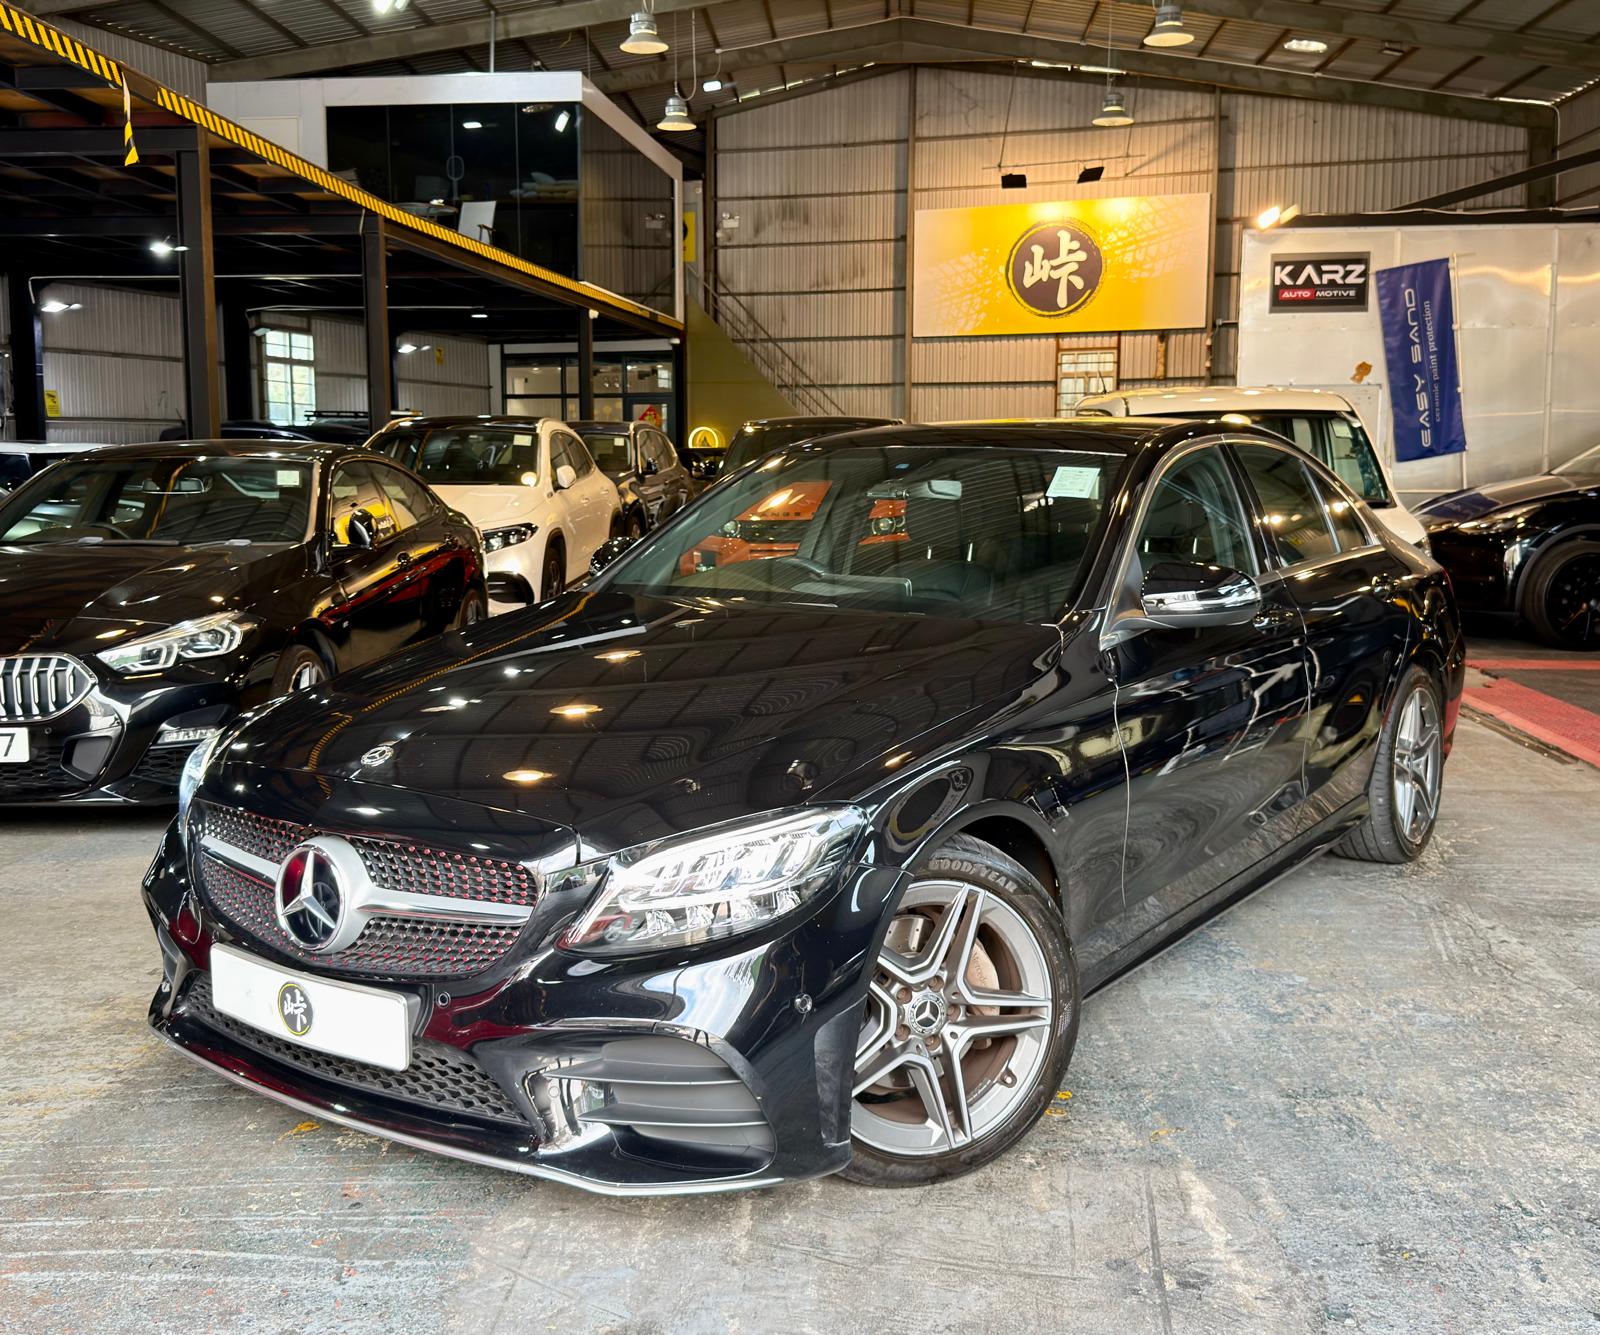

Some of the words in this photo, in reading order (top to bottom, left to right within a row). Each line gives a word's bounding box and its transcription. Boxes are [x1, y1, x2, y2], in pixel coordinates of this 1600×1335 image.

[1023, 230, 1087, 308] 峠
[1274, 264, 1366, 285] KARZ
[1281, 290, 1311, 298] AUTO
[1315, 289, 1357, 297] MOTIVE
[1404, 288, 1422, 364] SAND
[1424, 300, 1438, 352] protection
[1429, 354, 1440, 381] paint
[1413, 374, 1431, 447] EASY
[1433, 383, 1441, 423] ceramic
[928, 858, 1018, 893] GOODYEAR
[283, 988, 307, 1032] 峠
